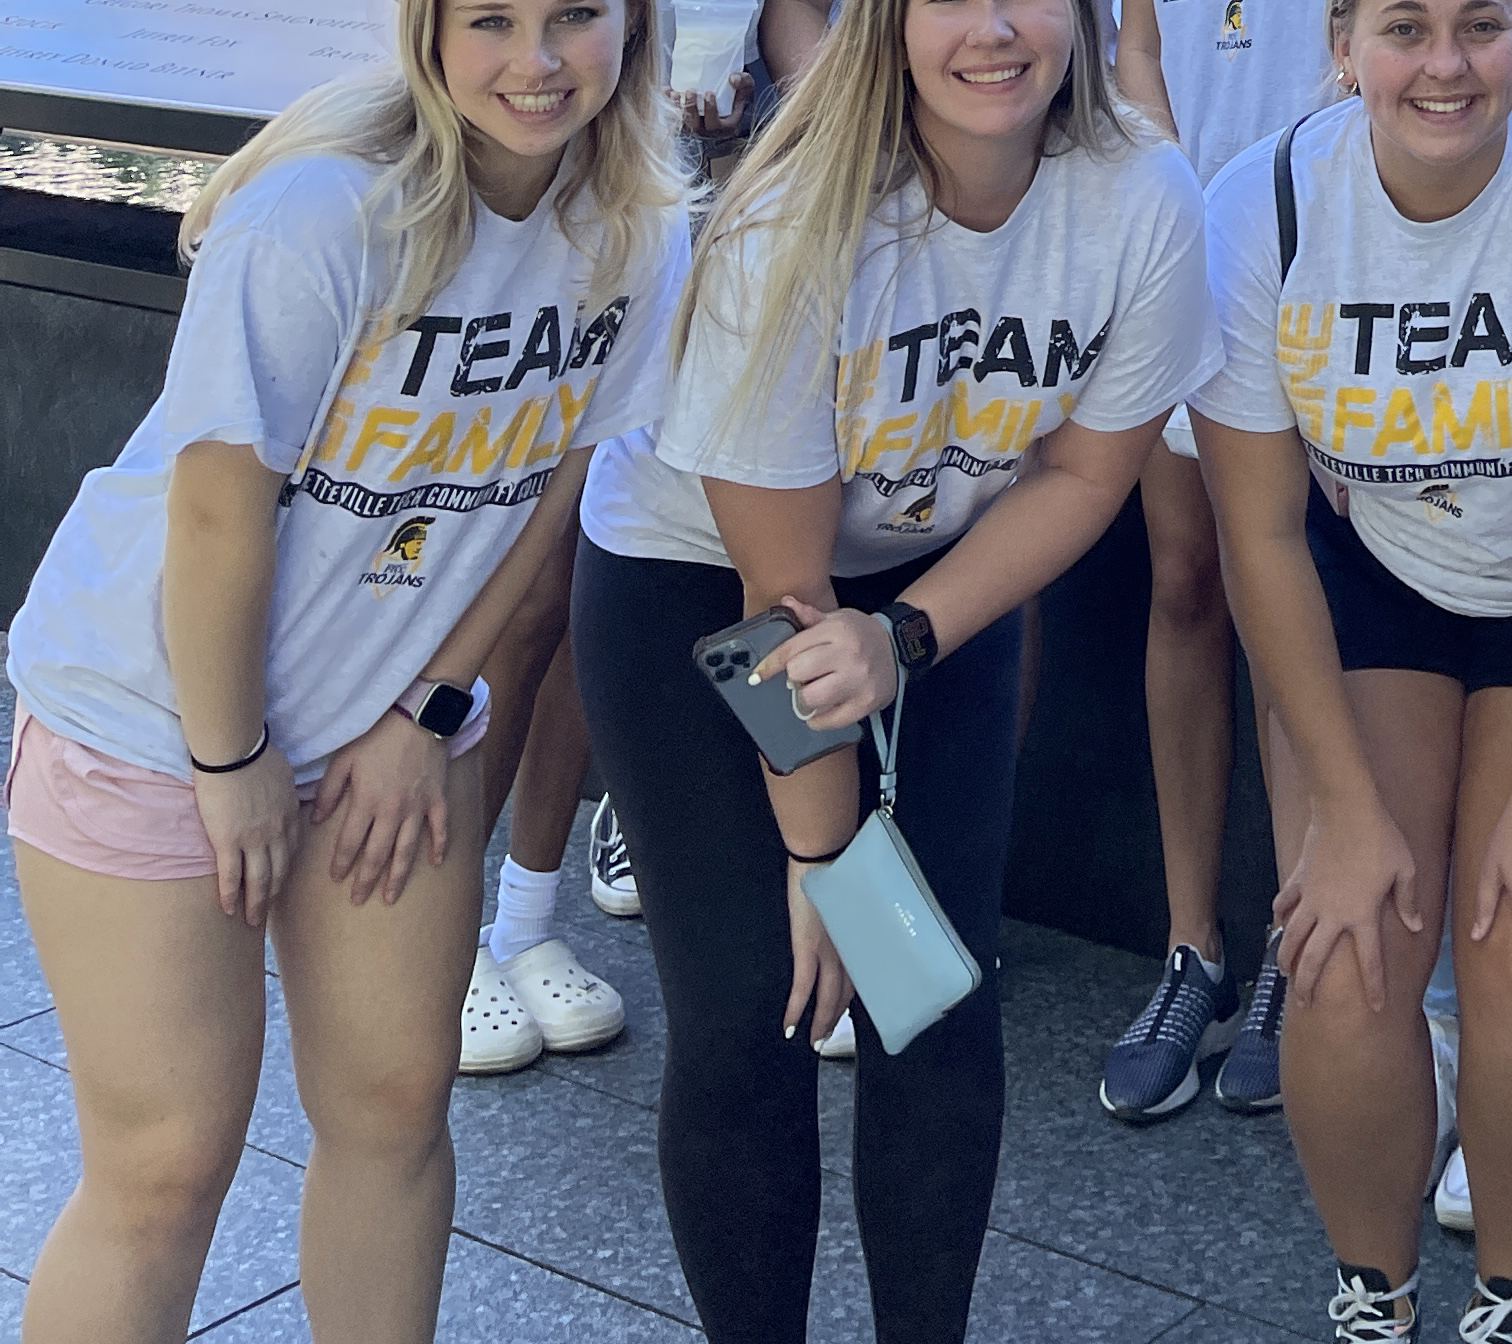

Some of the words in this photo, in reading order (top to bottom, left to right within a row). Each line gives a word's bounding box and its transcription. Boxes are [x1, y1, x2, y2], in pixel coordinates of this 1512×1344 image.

[198, 34, 245, 49] FOX
[400, 295, 632, 398] TEAM
[888, 308, 1114, 404] TEAM
[344, 377, 601, 483] FAMILY
[1385, 467, 1426, 483] TECH
[357, 572, 427, 590] TROJANS
